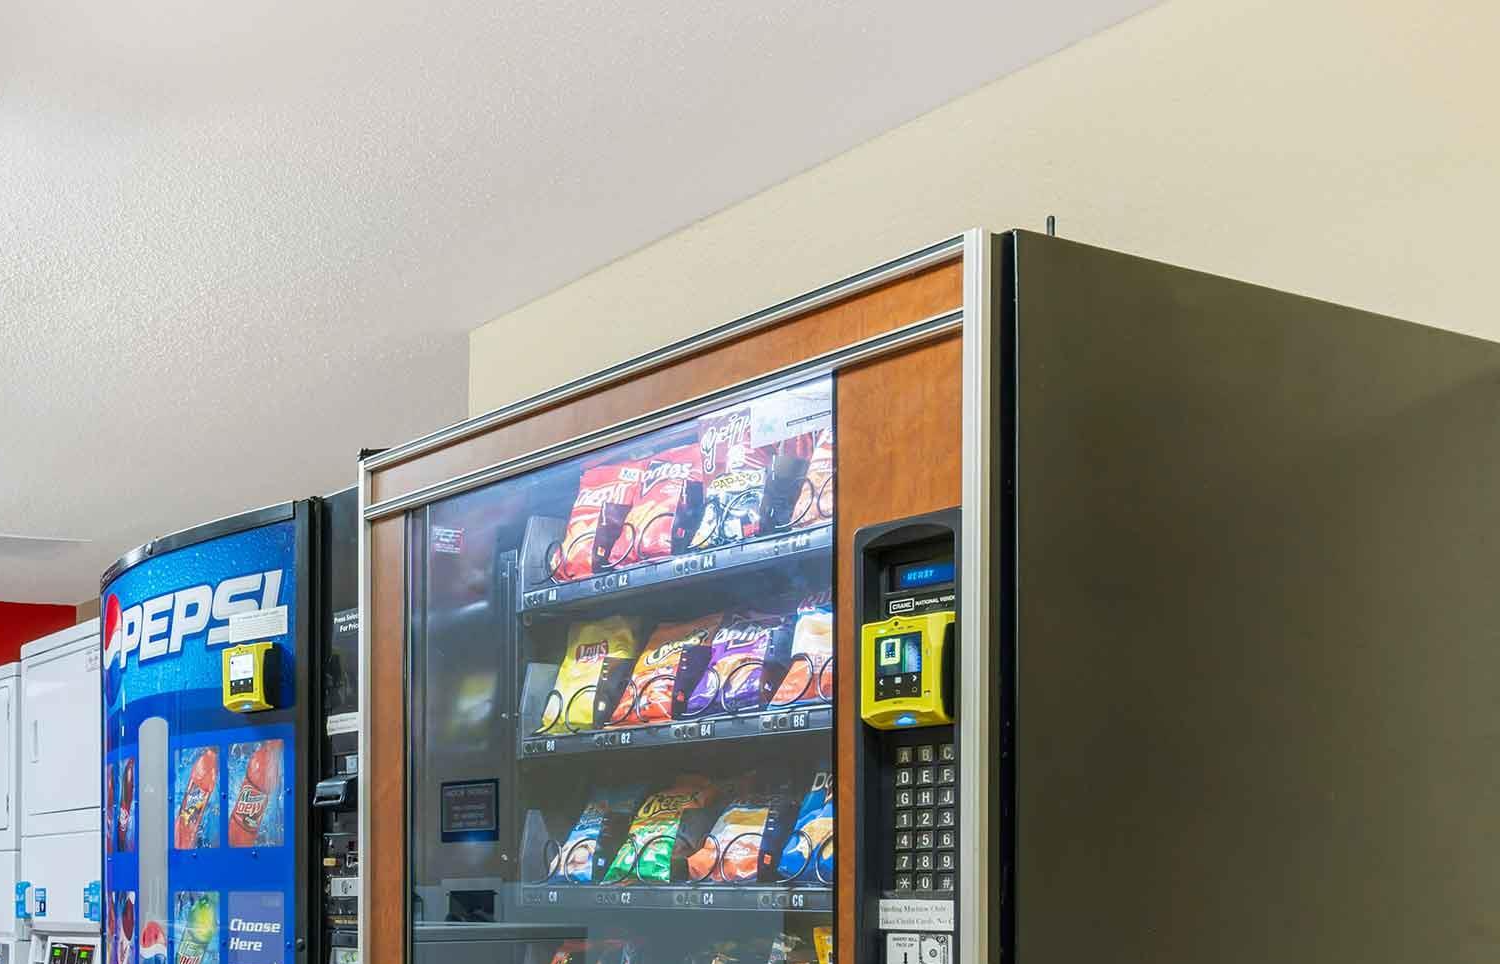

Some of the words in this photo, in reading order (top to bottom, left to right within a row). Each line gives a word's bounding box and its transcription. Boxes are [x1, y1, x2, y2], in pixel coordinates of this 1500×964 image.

[118, 569, 283, 669] PEPSI
[621, 892, 631, 904] C2
[703, 893, 714, 904] C4
[792, 894, 804, 907] C6
[230, 918, 281, 933] Choose
[230, 937, 262, 951] Here
